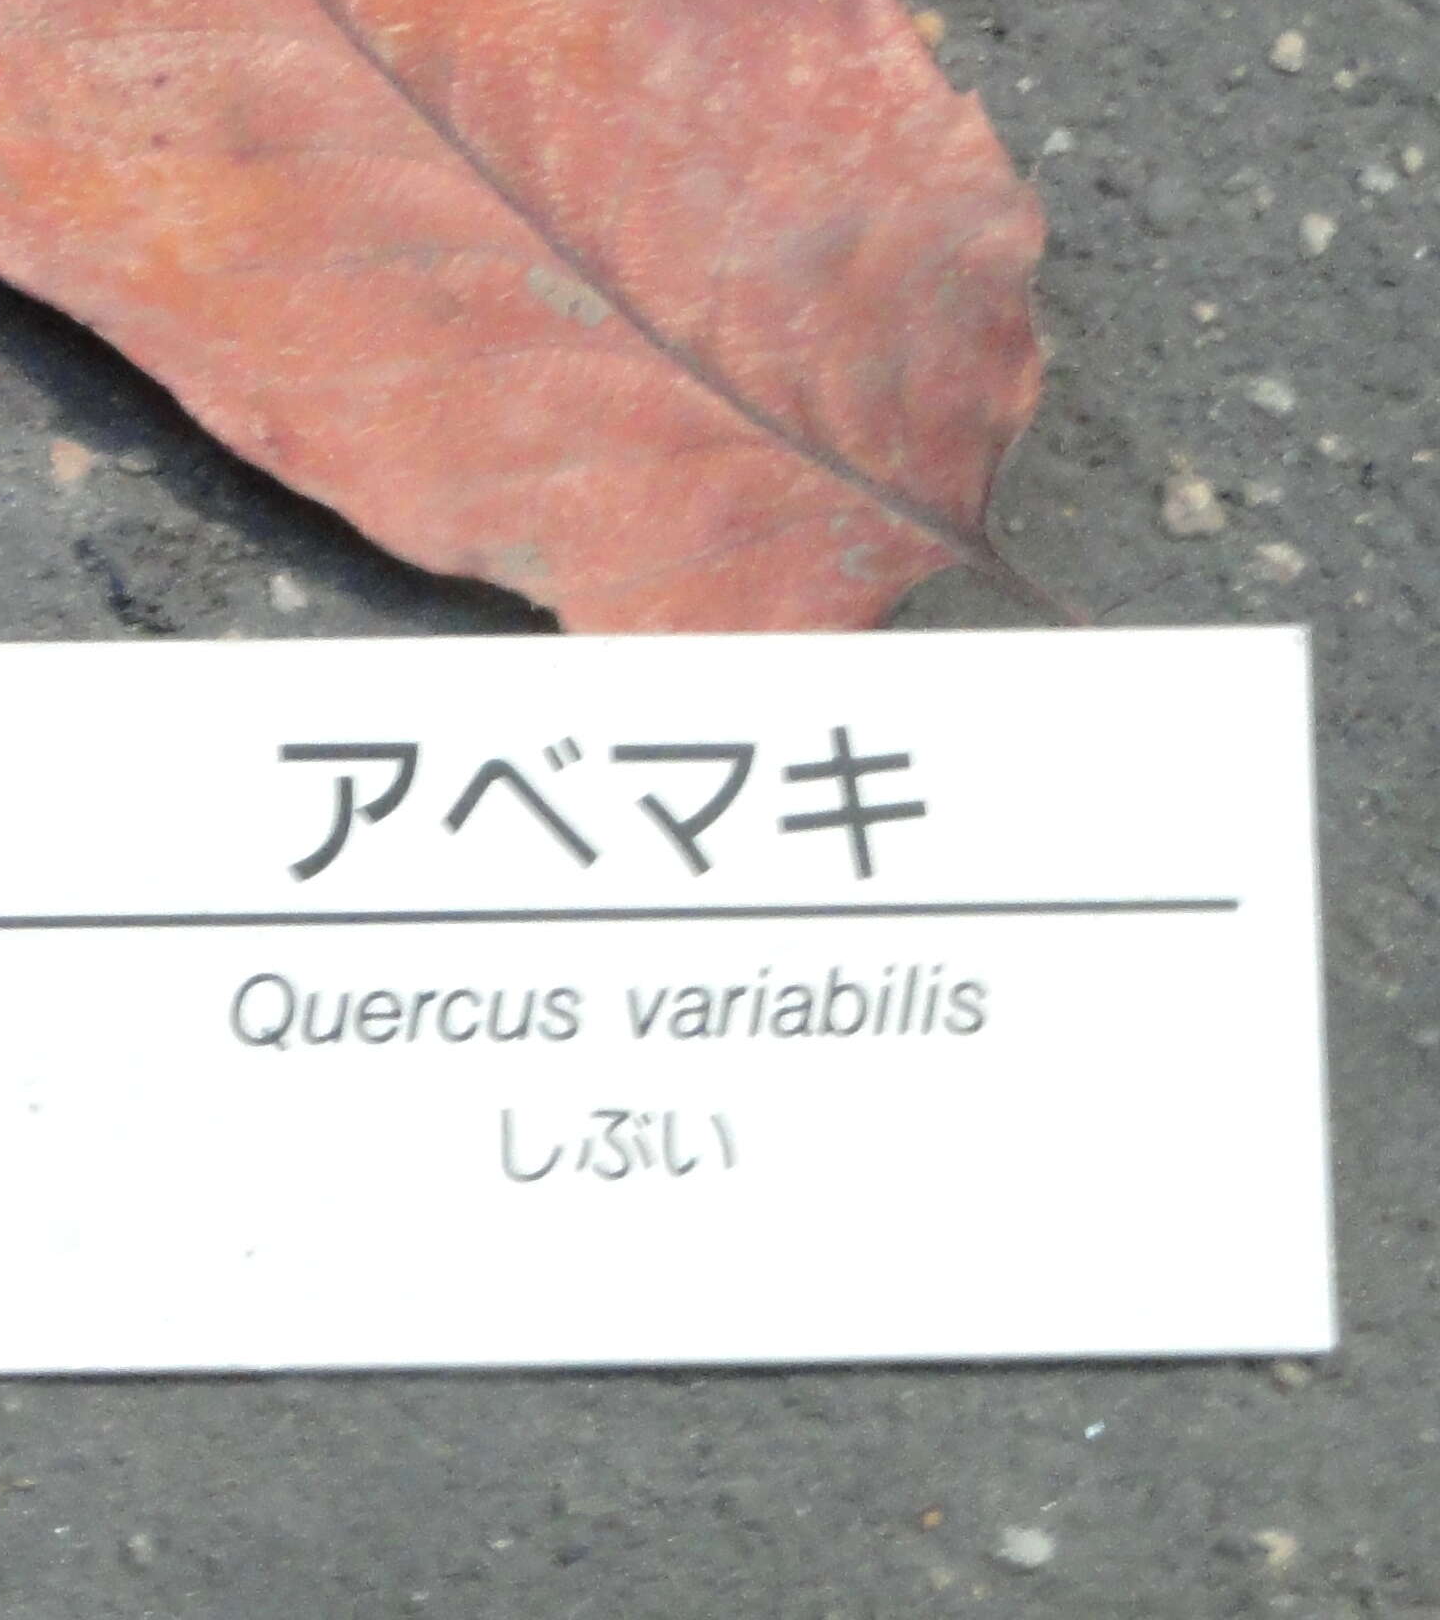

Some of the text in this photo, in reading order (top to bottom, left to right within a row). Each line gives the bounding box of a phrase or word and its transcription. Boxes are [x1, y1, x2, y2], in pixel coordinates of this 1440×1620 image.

[281, 726, 928, 883] アベマキ
[230, 962, 989, 1051] Quercus variabilis
[497, 1105, 737, 1183] しぶい
